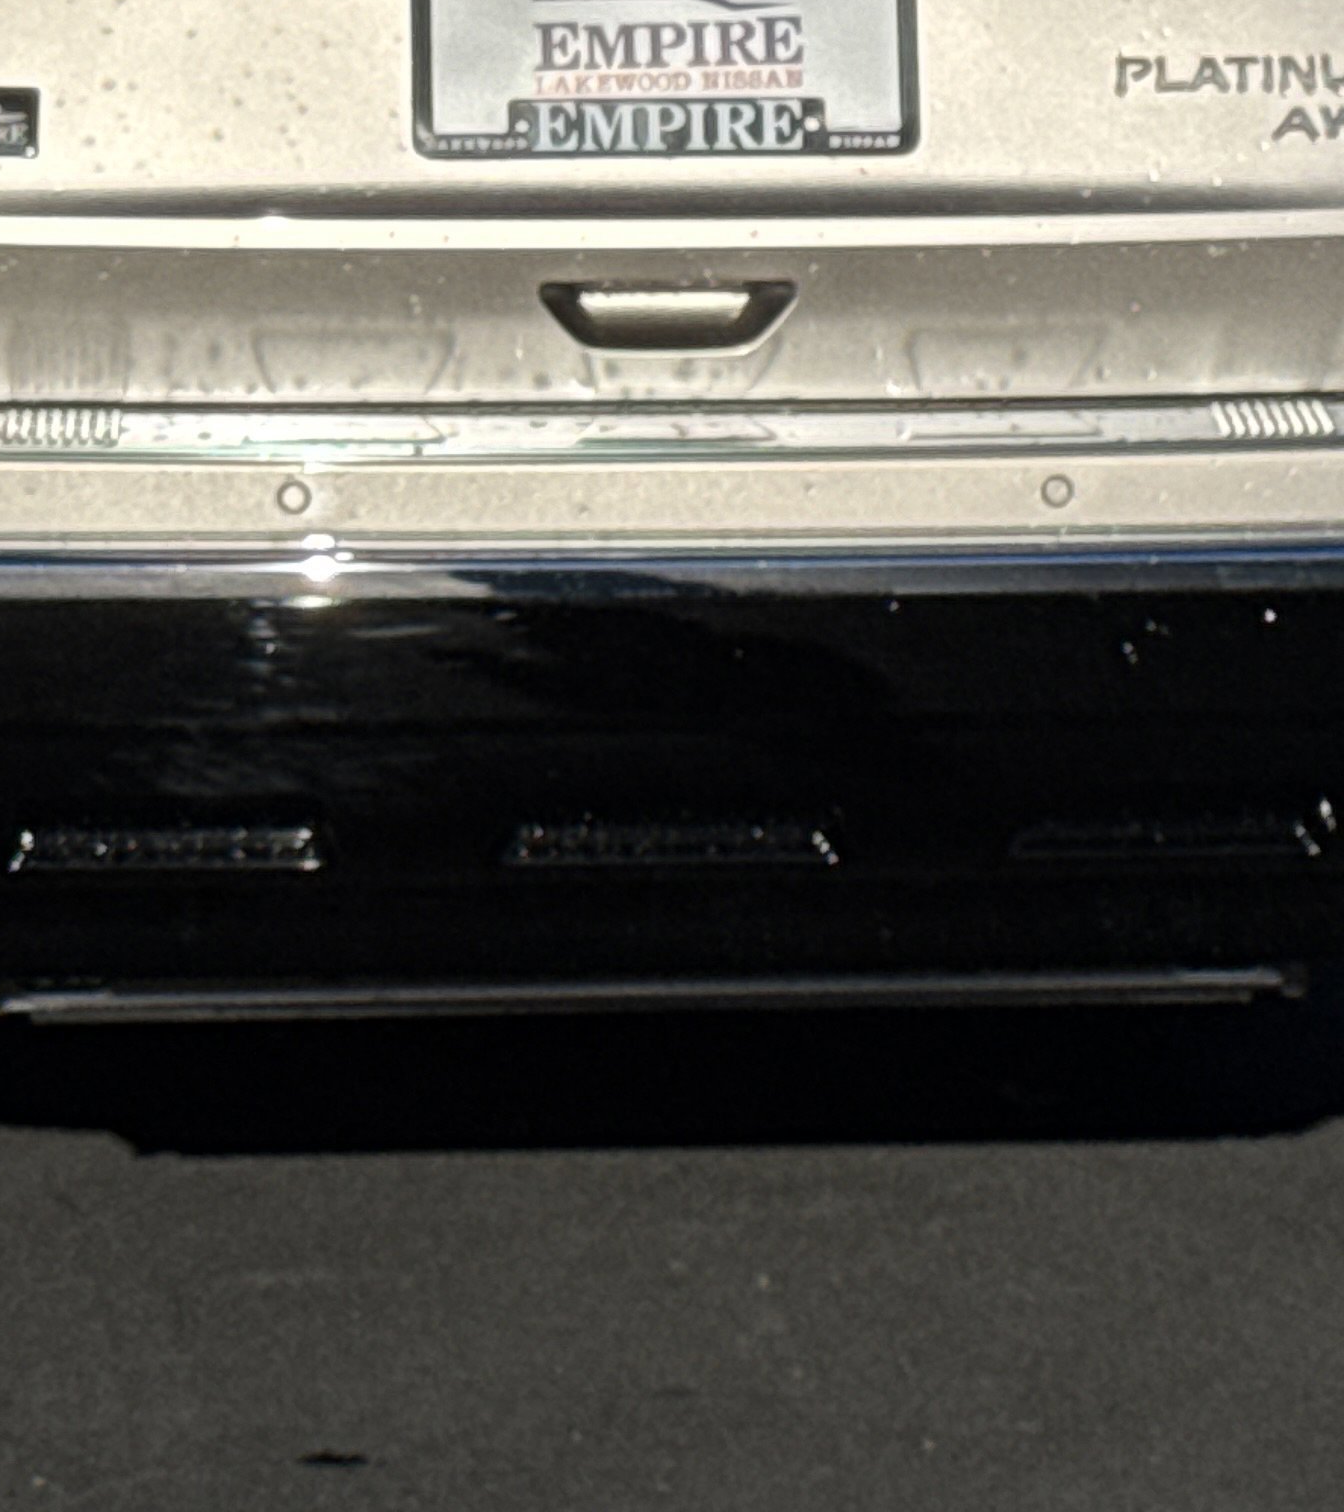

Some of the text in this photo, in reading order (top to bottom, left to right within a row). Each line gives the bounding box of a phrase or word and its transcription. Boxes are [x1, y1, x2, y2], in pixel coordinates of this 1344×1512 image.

[533, 16, 804, 72] EMPIRE
[534, 68, 804, 95] LAKEWOOD NISSAN
[530, 99, 804, 153] EMPIRE
